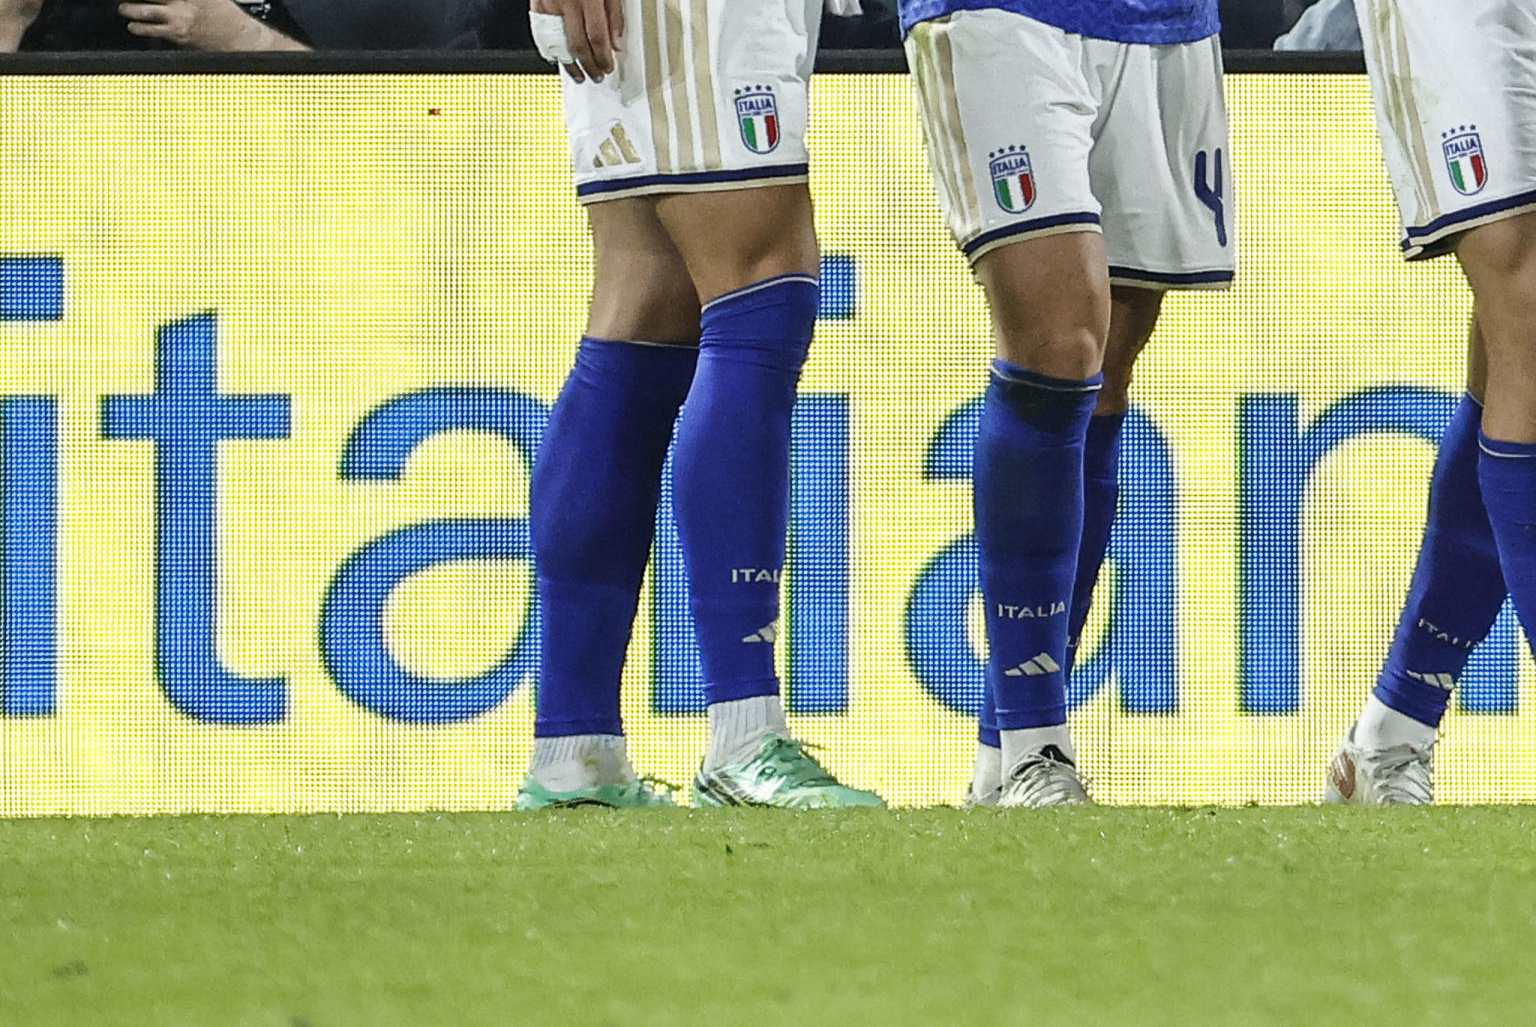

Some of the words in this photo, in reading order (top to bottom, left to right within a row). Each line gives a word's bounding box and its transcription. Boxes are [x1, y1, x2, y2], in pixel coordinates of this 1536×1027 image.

[739, 98, 773, 113] ITALIA
[1446, 138, 1478, 156] ITALIA
[992, 157, 1027, 175] ITALIA
[1194, 148, 1228, 246] 4
[998, 601, 1065, 619] ITALIA
